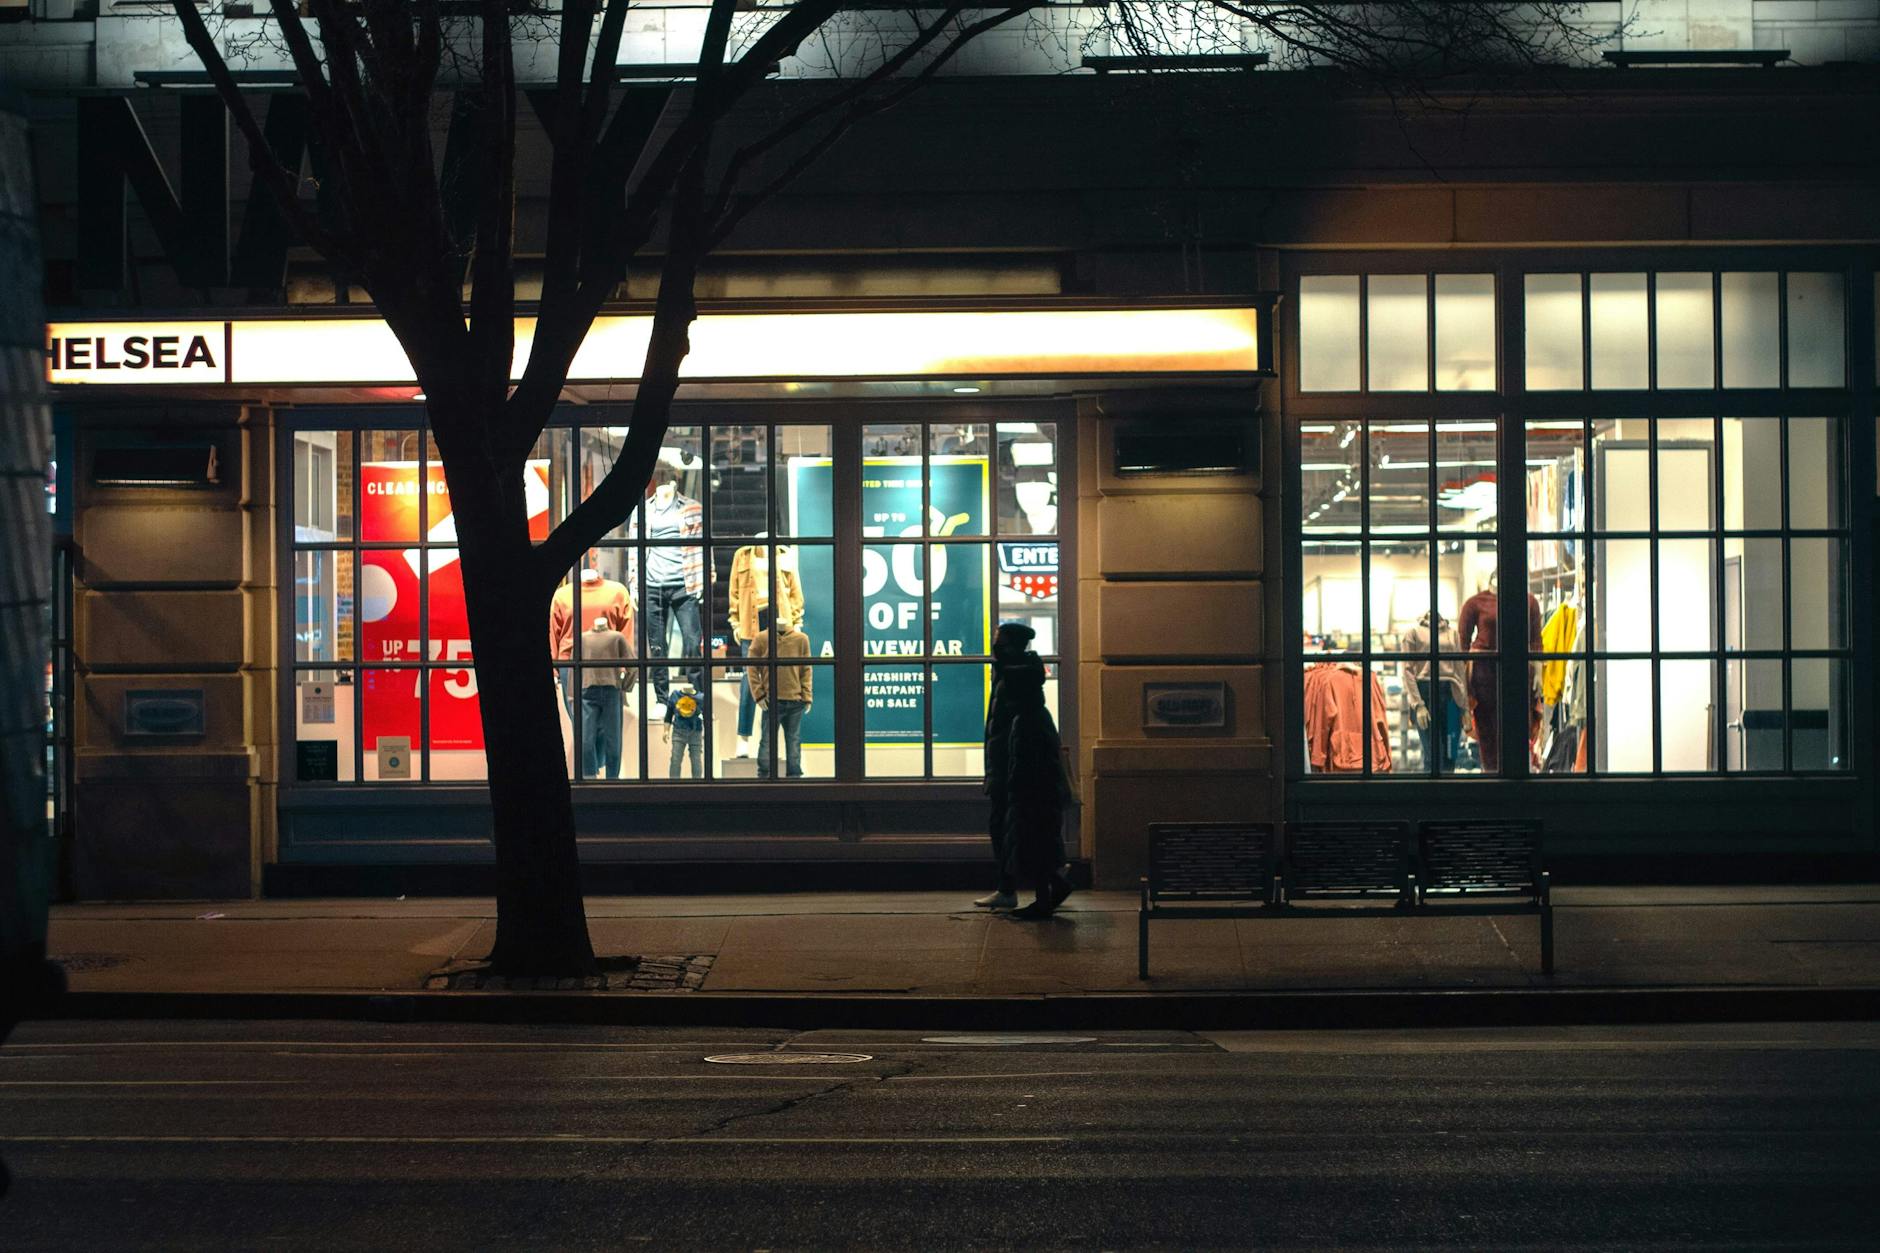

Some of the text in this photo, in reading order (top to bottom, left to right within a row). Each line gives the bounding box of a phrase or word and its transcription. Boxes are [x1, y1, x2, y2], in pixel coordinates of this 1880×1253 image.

[46, 336, 216, 370] HELSEA
[367, 481, 449, 496] CLEARNC
[874, 513, 906, 522] UP TO
[1012, 547, 1058, 565] ENTE
[382, 640, 403, 655] UP
[863, 672, 924, 681] EATSHIRTS
[864, 686, 925, 695] WEATPANT
[867, 698, 917, 708] ON SALE
